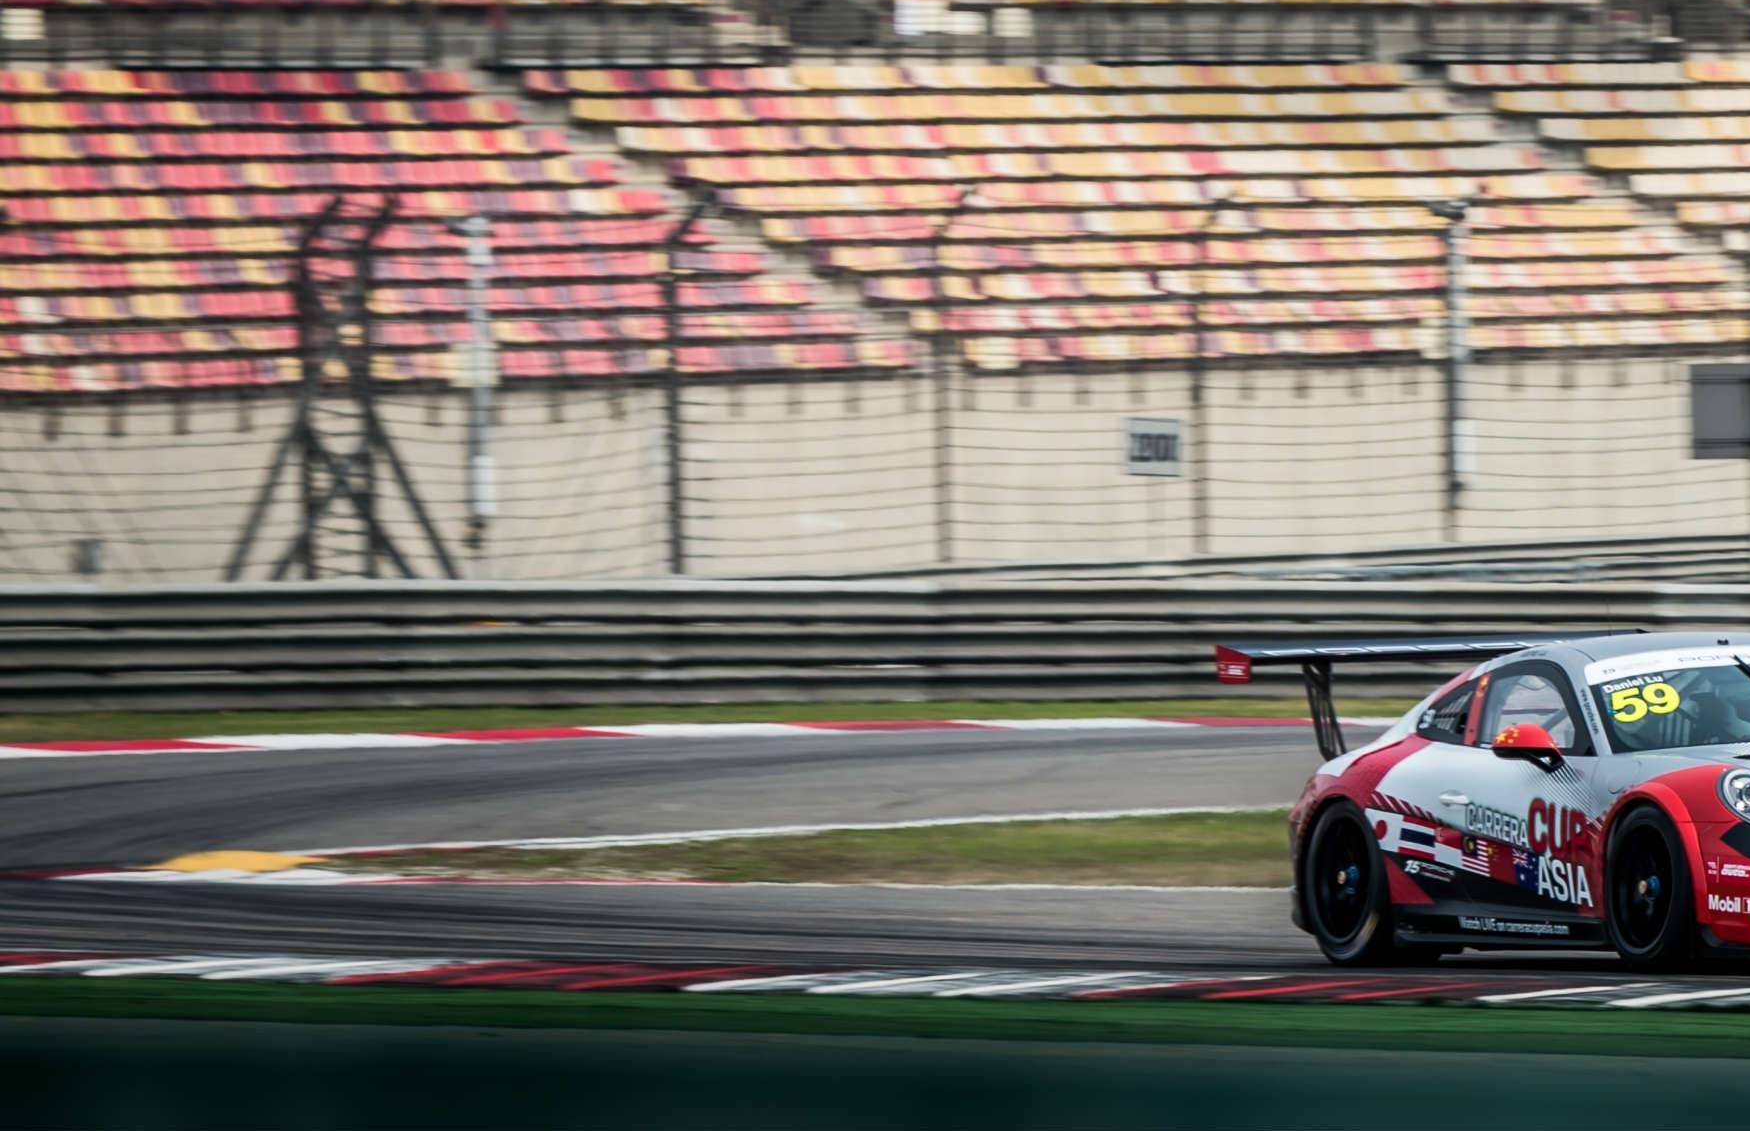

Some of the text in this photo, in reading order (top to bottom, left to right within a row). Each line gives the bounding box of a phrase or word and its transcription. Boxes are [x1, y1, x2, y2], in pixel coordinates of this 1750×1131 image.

[1602, 675, 1664, 693] Daniel Lu
[1611, 682, 1680, 723] 59
[1465, 797, 1587, 859] CARRERA CUP
[1537, 854, 1594, 908] ASIA
[1708, 894, 1741, 913] Mobil
